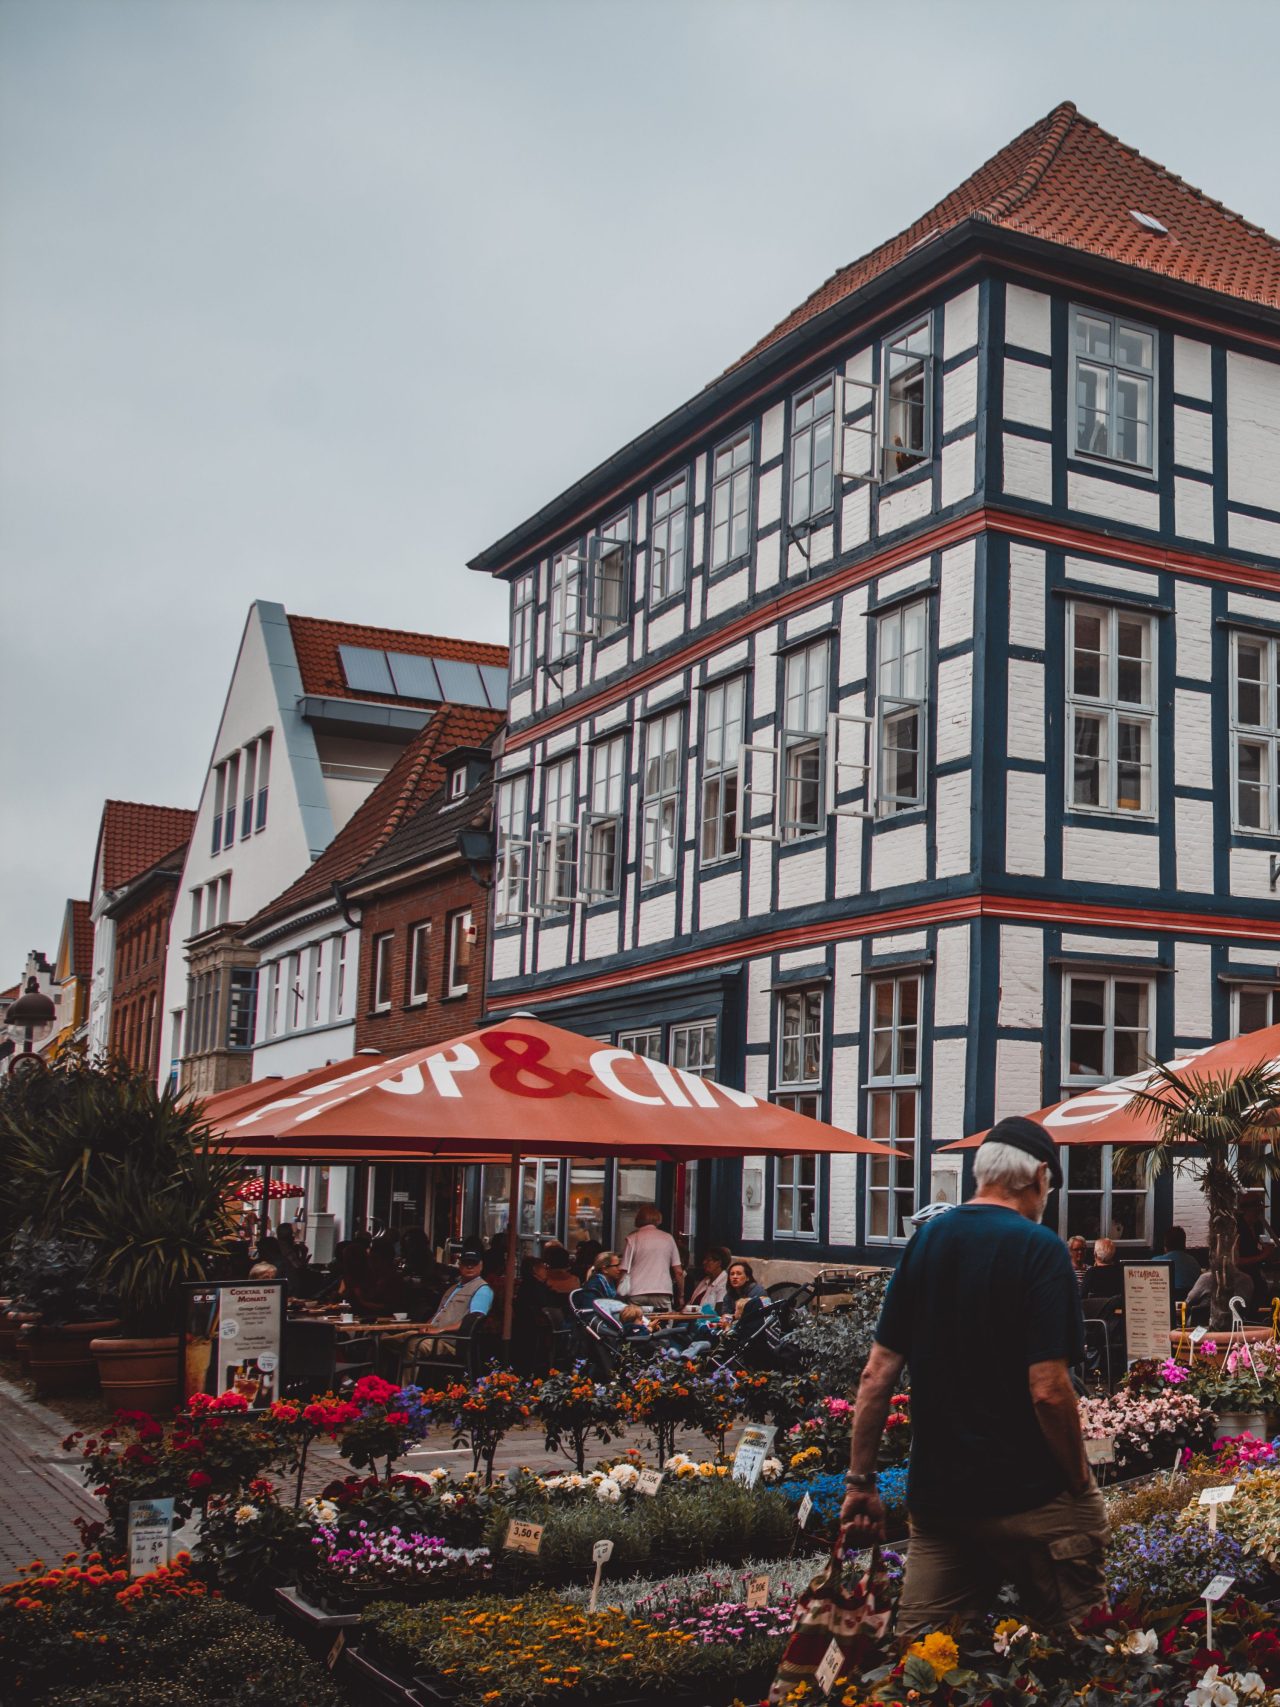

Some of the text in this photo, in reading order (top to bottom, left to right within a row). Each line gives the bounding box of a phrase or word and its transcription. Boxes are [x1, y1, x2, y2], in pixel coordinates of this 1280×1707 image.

[479, 1031, 610, 1099] &
[513, 1526, 540, 1540] 3,50 €
